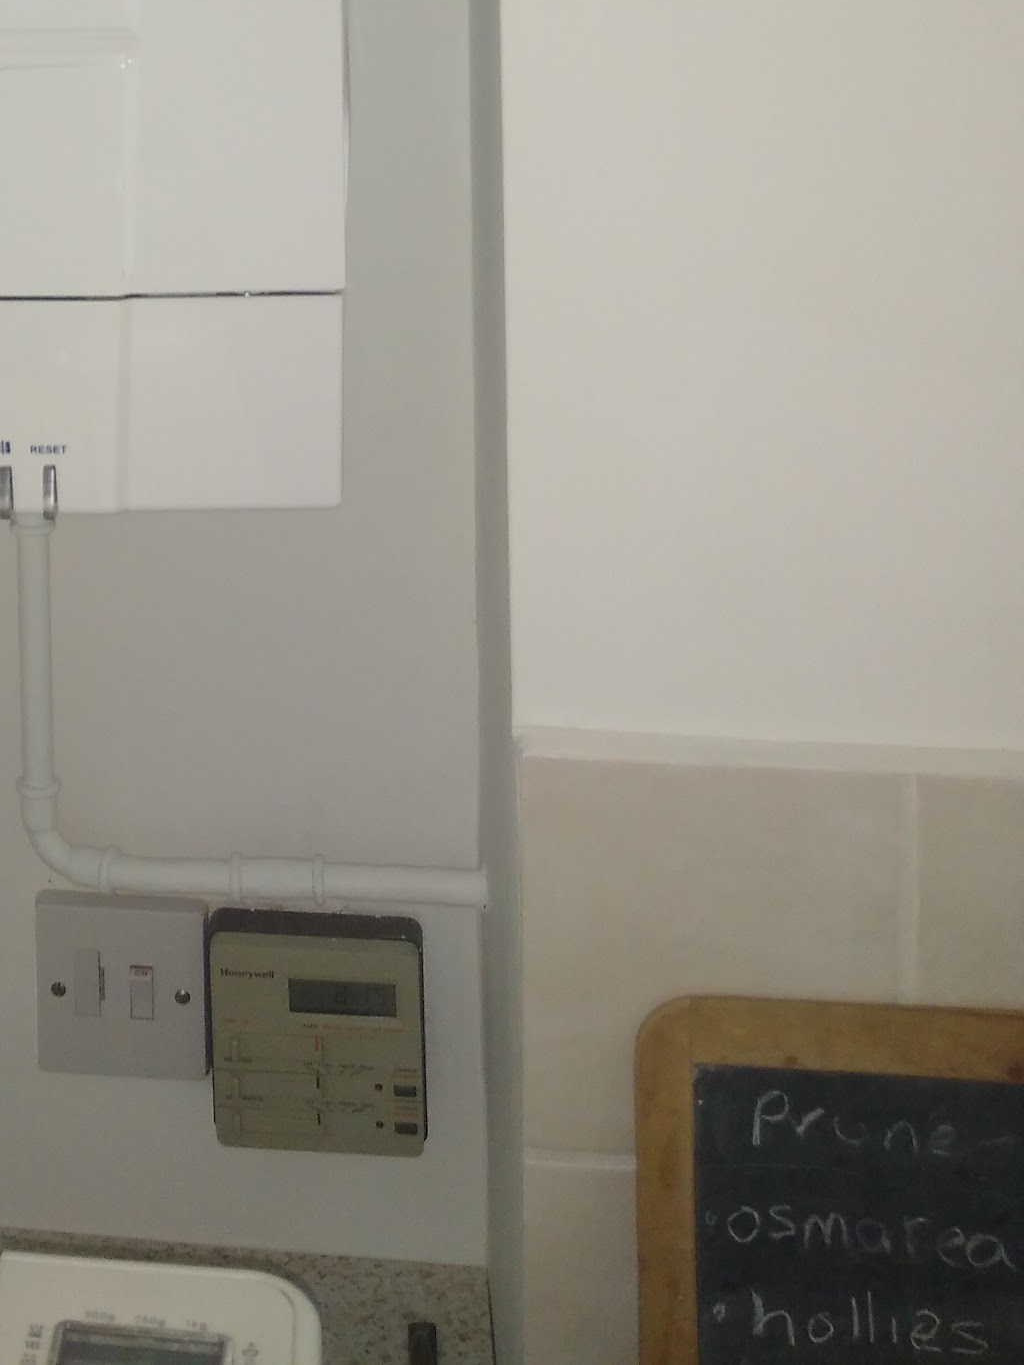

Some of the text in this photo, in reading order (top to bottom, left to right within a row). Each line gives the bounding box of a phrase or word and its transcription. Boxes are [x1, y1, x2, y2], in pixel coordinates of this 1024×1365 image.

[29, 444, 68, 454] RESET
[220, 968, 275, 980] Honeywell
[752, 1090, 956, 1156] Prune
[751, 1289, 989, 1356] hollies
